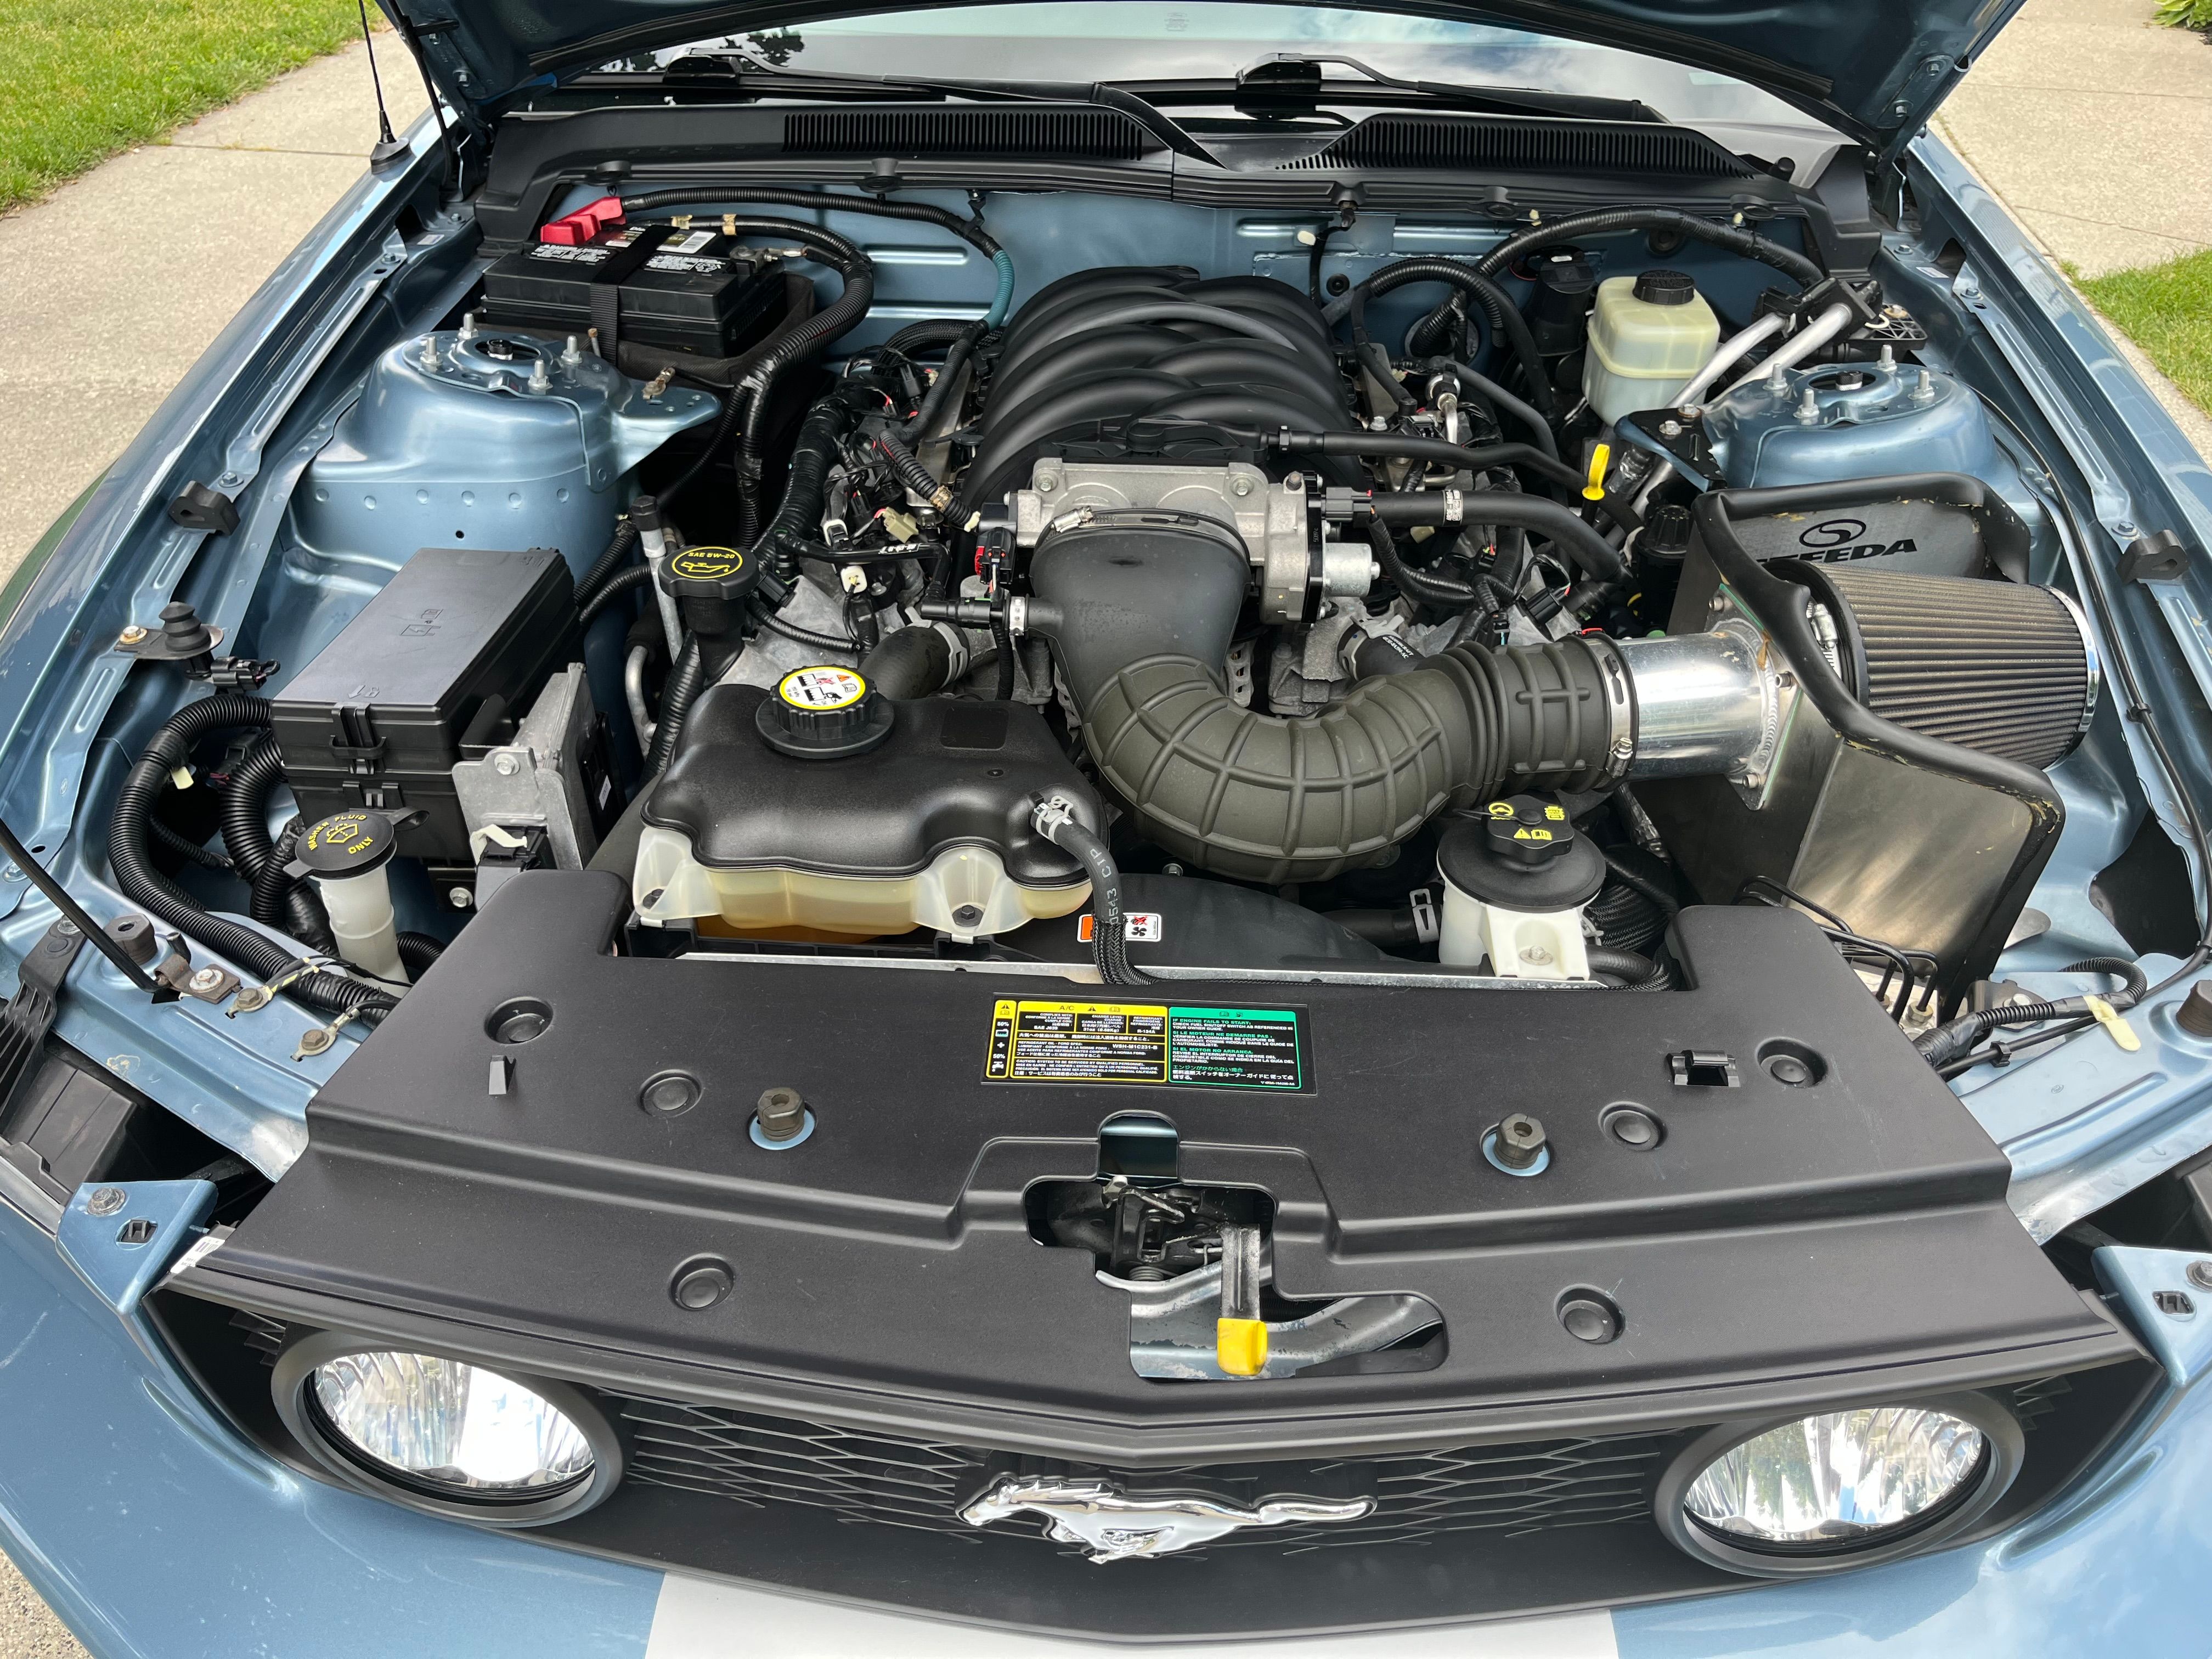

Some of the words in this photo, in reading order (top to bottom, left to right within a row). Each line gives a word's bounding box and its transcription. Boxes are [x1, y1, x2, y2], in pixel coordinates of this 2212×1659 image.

[1756, 539, 1917, 563] EEDA
[307, 821, 329, 851] WASHER
[335, 814, 367, 822] FLUID
[348, 836, 374, 854] ONLY
